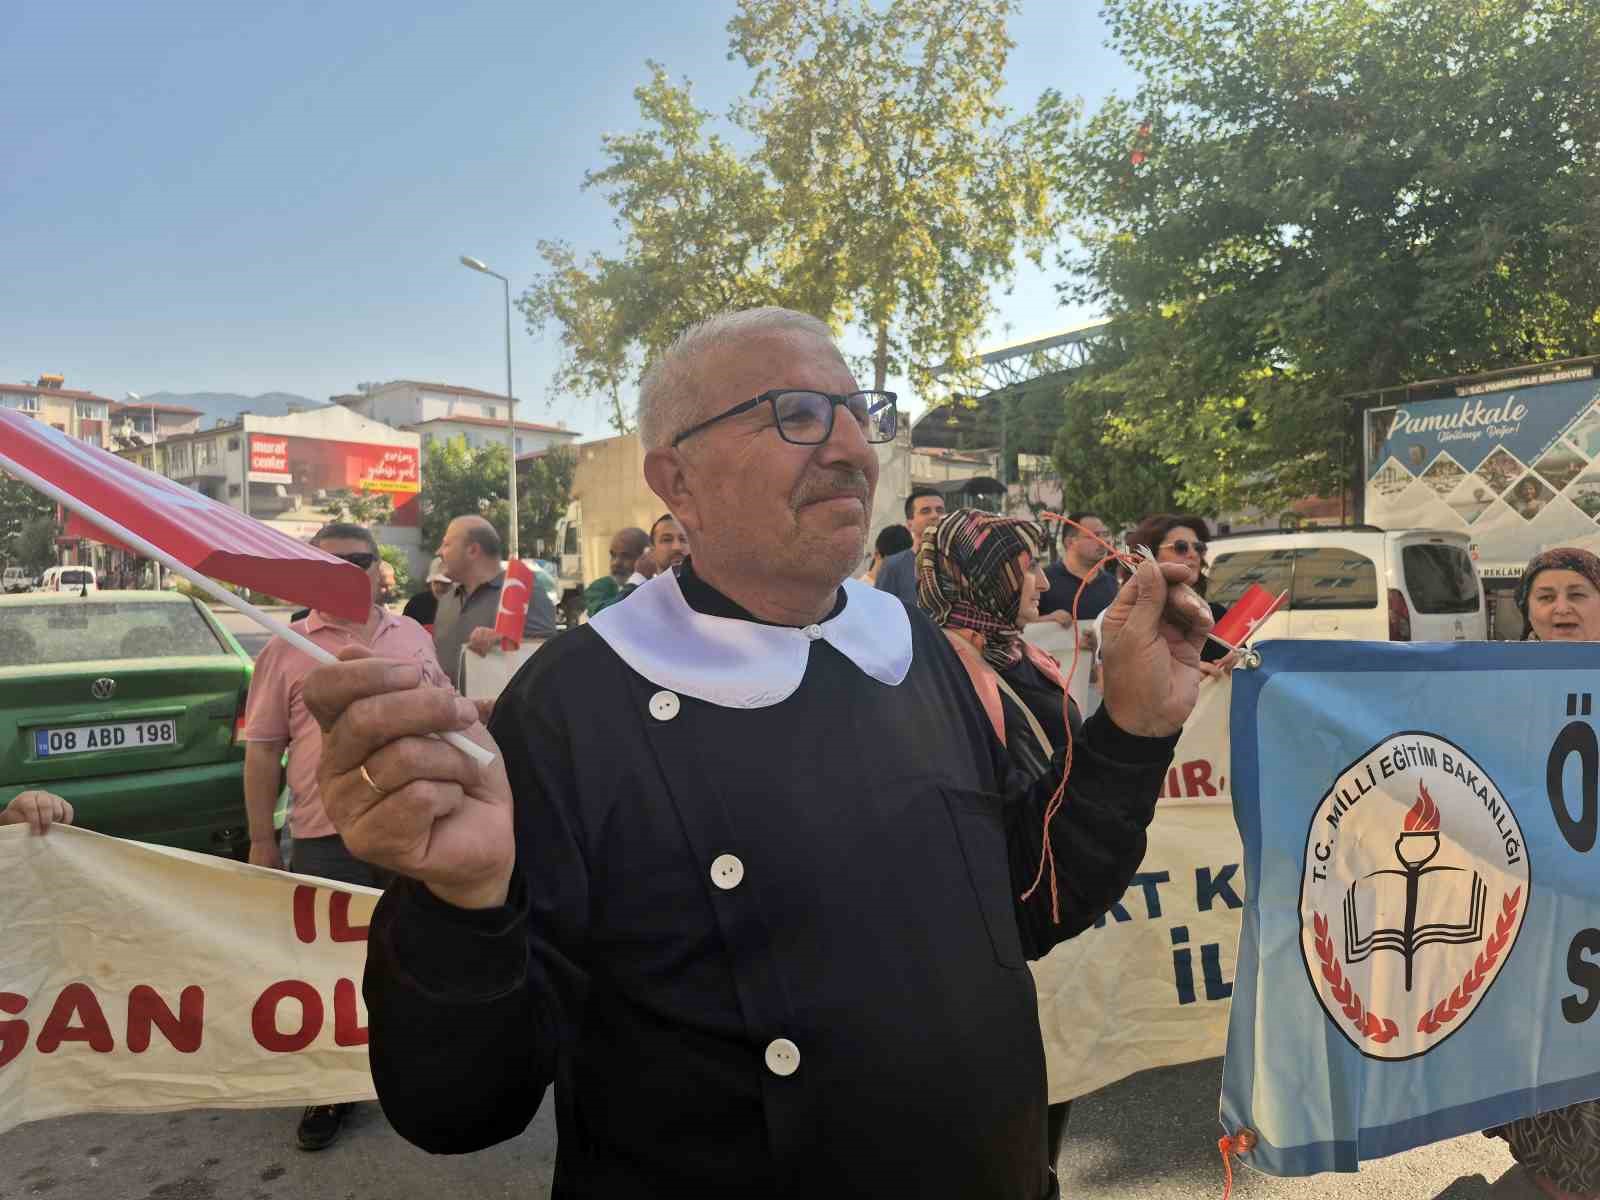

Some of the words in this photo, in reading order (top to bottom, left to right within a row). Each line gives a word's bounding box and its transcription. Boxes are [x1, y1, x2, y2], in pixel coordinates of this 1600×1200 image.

[1386, 395, 1529, 440] Pamukkale
[50, 731, 76, 751] 08
[87, 727, 125, 748] ABD
[136, 723, 172, 744] 198
[1312, 839, 1334, 883] T.C.
[1326, 764, 1377, 829] MİLLİ
[1379, 741, 1438, 779] EĞİTİM
[1442, 752, 1521, 865] BAKANLIĞI
[252, 978, 368, 1052] OL
